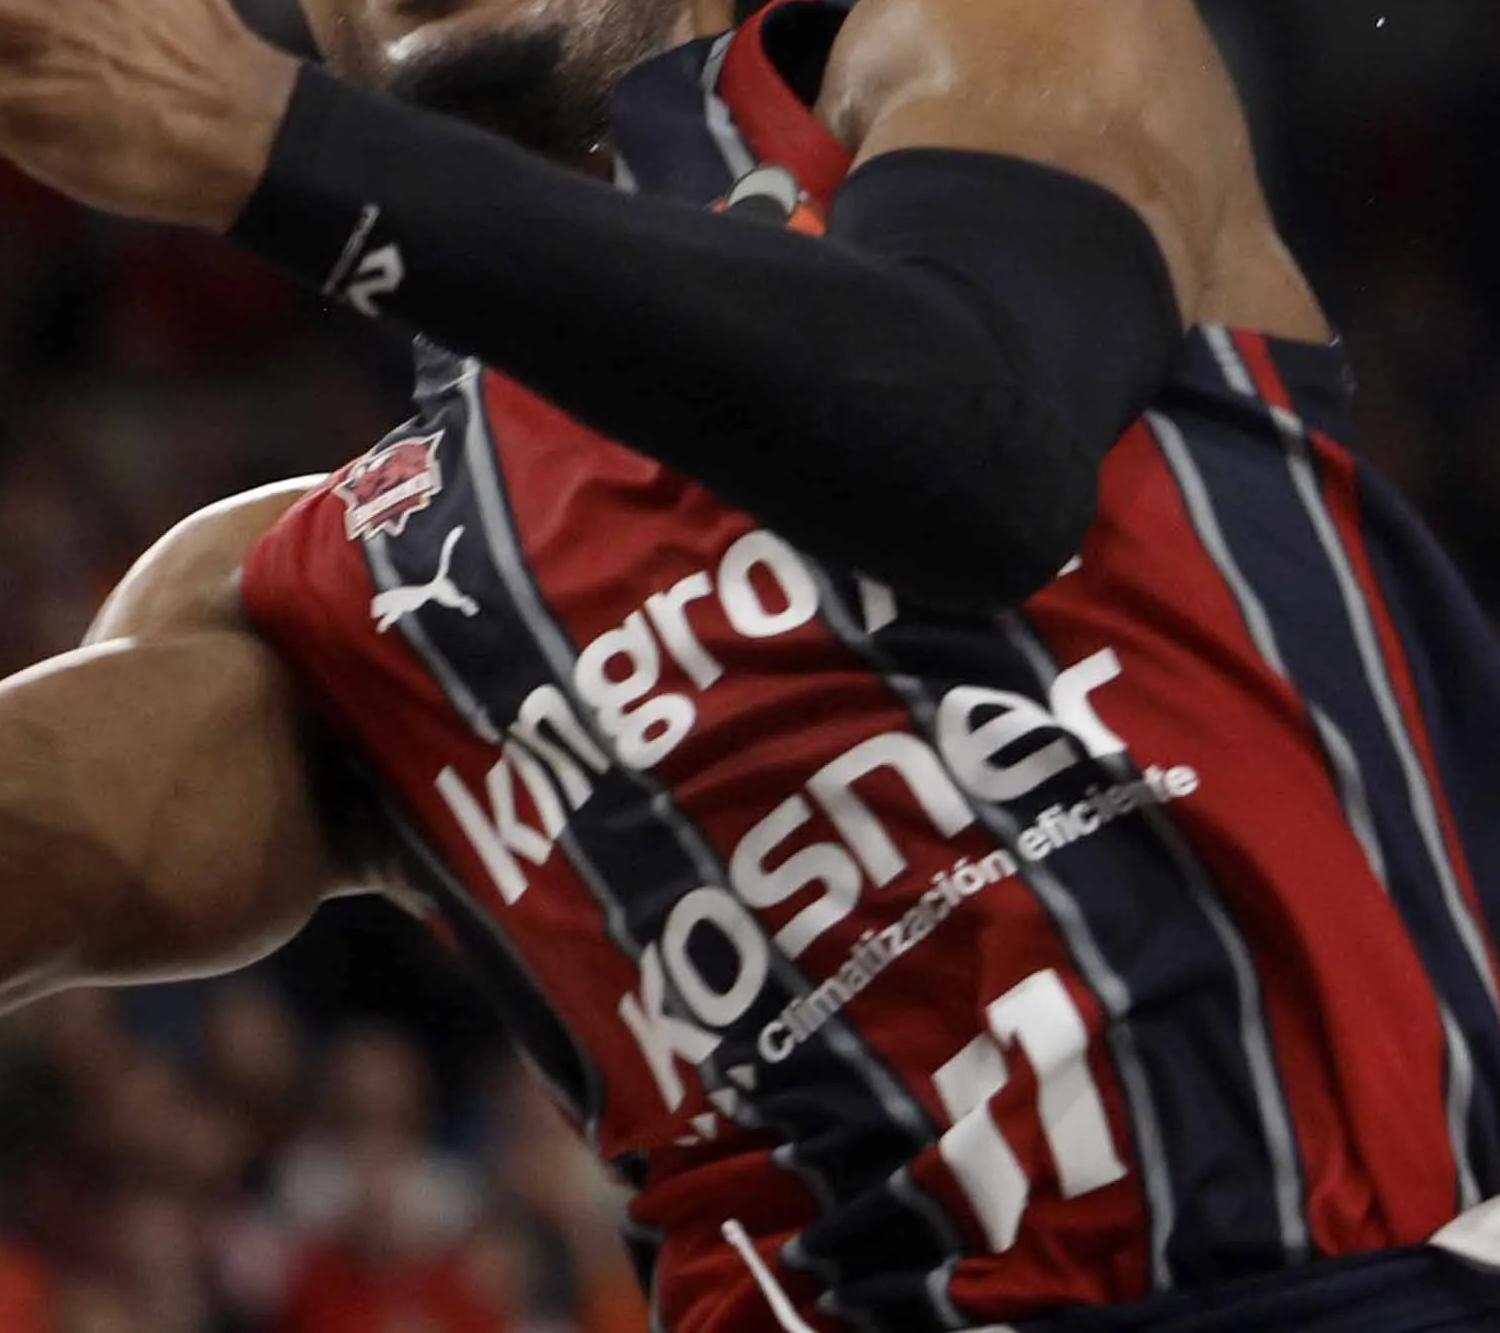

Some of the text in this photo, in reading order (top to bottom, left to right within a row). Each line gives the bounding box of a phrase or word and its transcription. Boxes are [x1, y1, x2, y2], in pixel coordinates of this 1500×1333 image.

[433, 528, 898, 907] kingro
[617, 647, 1124, 1115] kosner
[757, 848, 1020, 1065] climatización
[931, 968, 1128, 1254] 11
